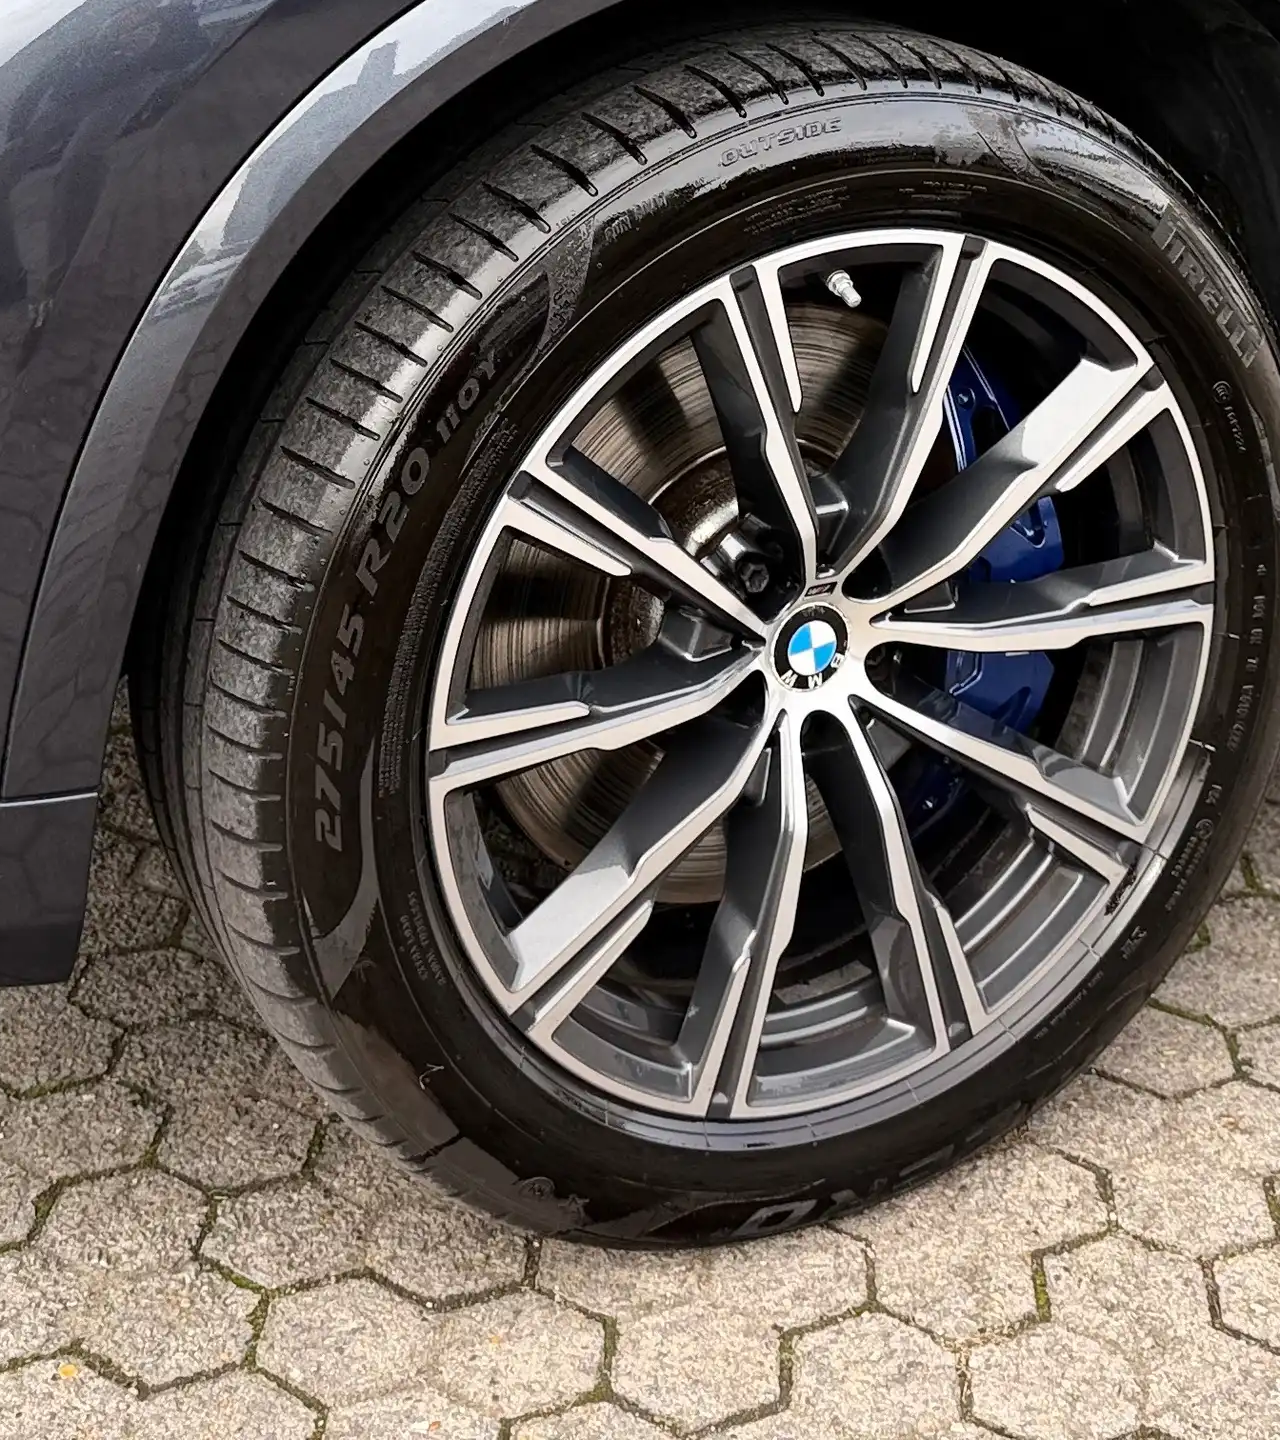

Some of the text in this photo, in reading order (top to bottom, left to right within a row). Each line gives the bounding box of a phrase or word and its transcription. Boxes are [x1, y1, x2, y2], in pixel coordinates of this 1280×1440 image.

[718, 116, 843, 167] OUTSIDE
[1151, 203, 1265, 368] PIRELLI
[781, 651, 845, 689] BMW
[314, 603, 365, 852] 275/45
